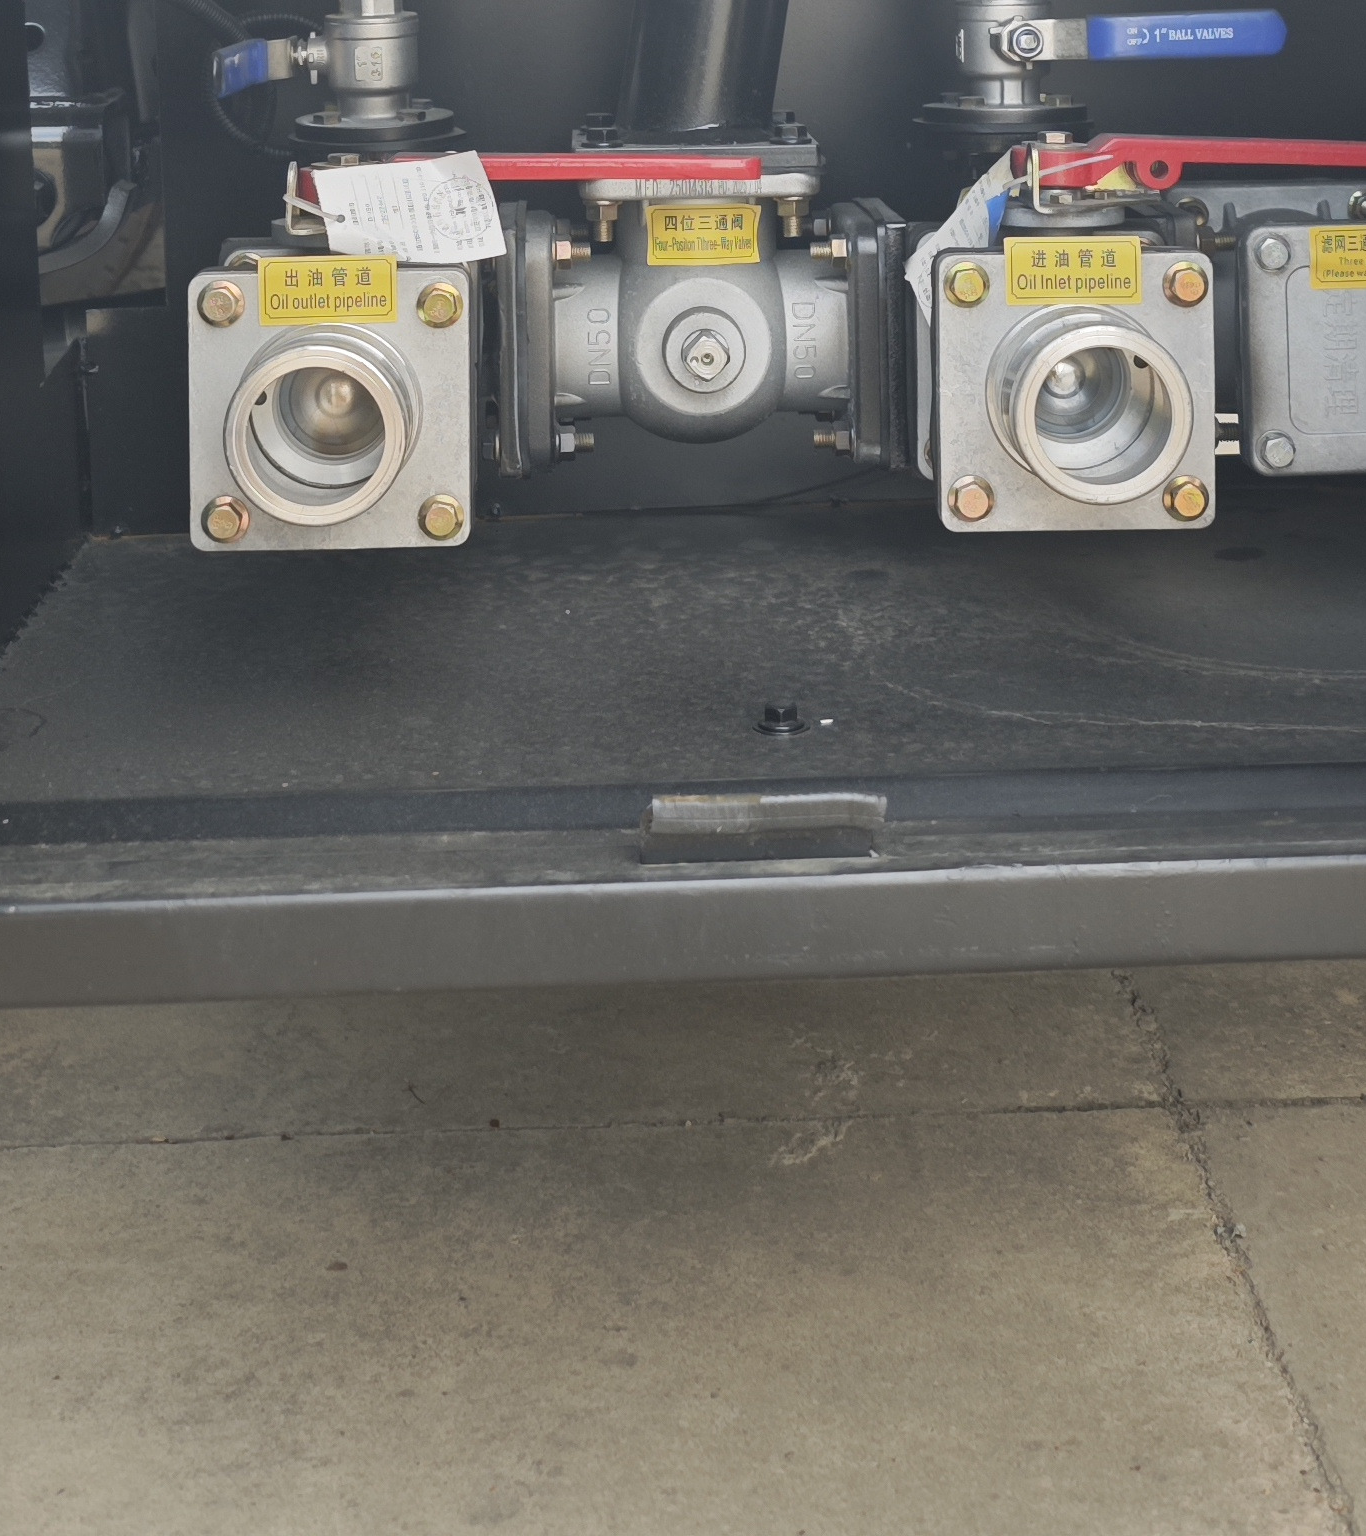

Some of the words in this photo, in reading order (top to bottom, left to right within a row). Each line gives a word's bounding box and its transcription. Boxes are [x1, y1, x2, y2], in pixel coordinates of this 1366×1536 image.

[1168, 28, 1194, 41] BALL
[1195, 27, 1234, 40] VALVES
[664, 214, 744, 232] 四位三通阀
[1031, 248, 1117, 269] 进油管道
[1339, 256, 1363, 266] Three
[284, 266, 372, 289] 出油管道
[1017, 274, 1037, 290] Oil
[1041, 274, 1072, 290] Inlet
[1075, 273, 1132, 293] pipeline
[1322, 268, 1355, 280] (Please
[270, 293, 289, 310] Oil
[292, 292, 331, 310] outlet
[334, 291, 387, 313] pipeline
[586, 307, 612, 386] DN50
[791, 301, 818, 380] DN50
